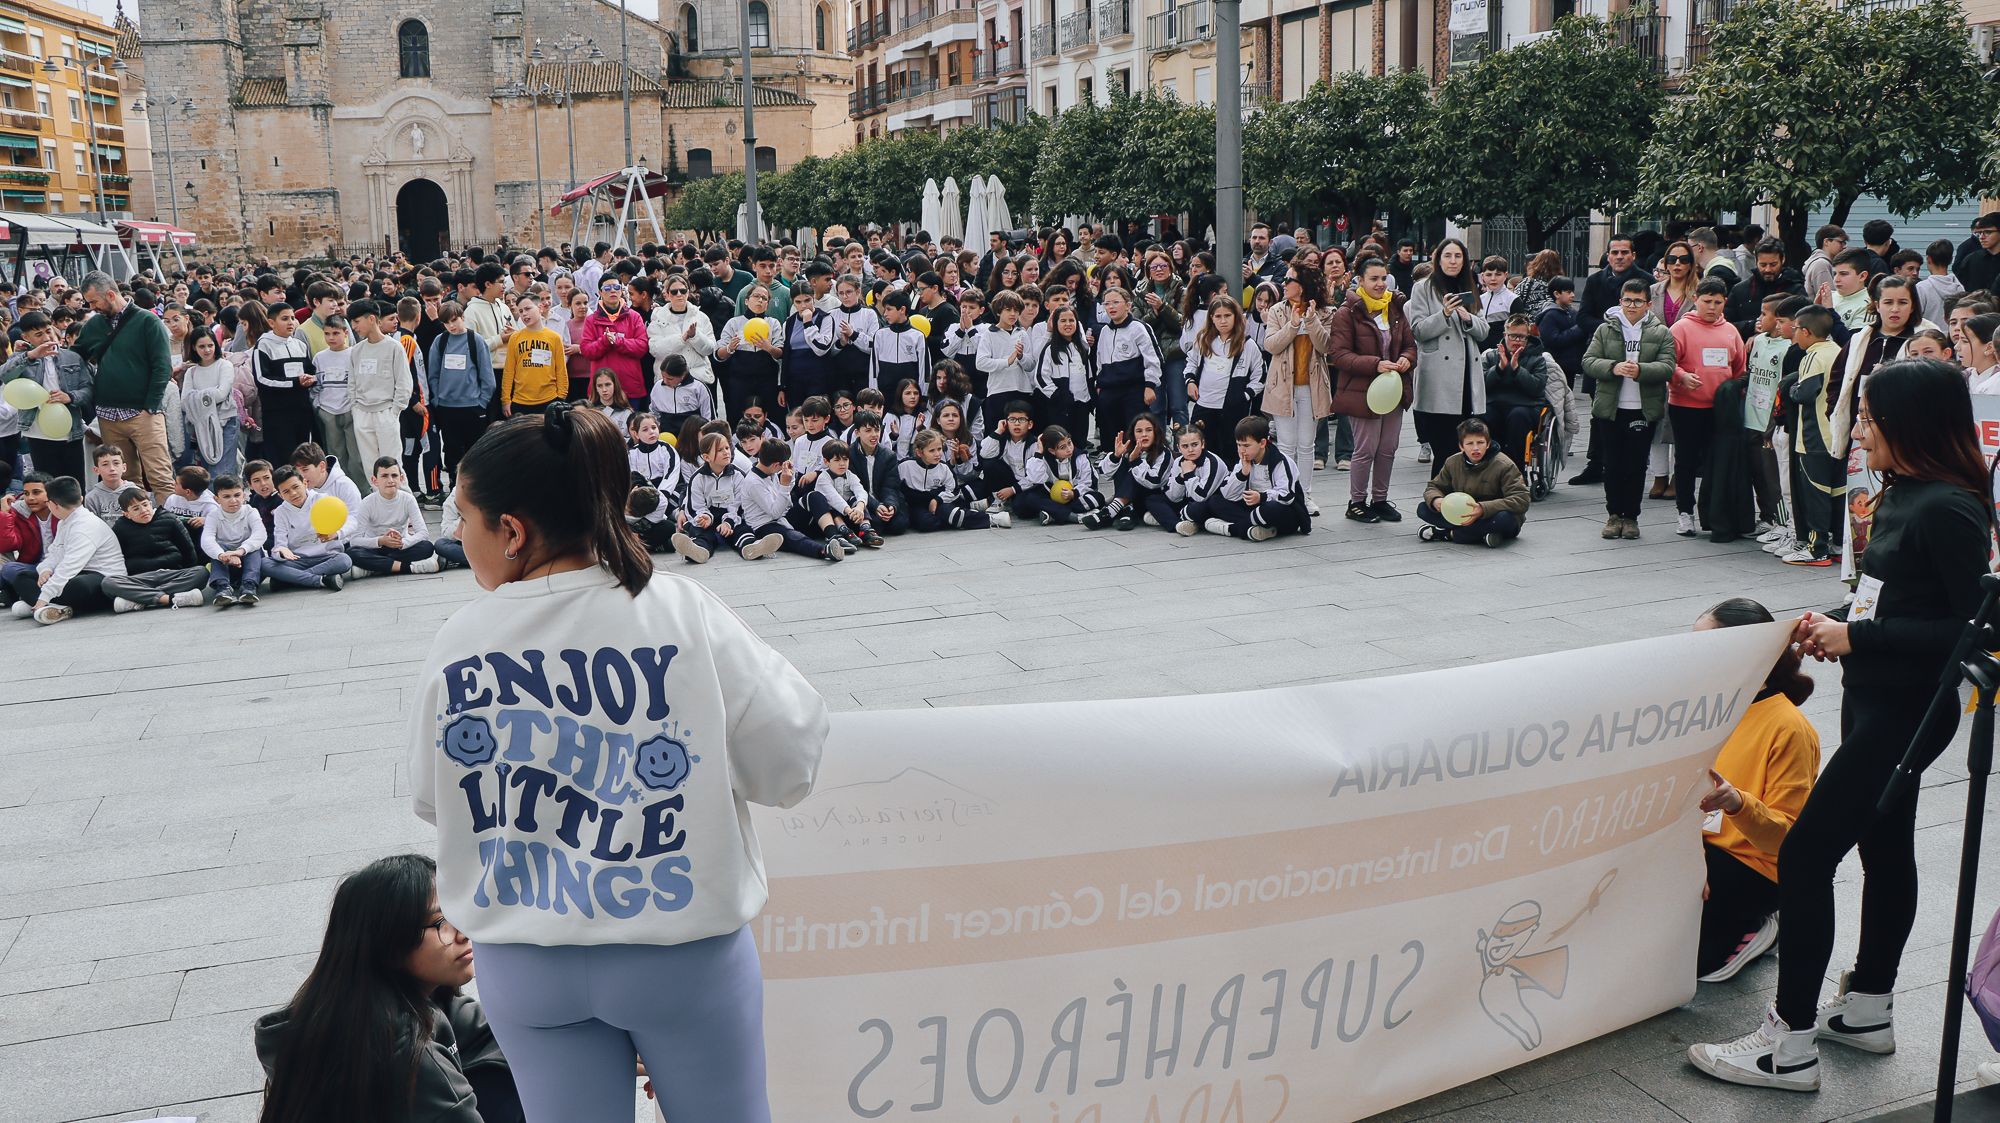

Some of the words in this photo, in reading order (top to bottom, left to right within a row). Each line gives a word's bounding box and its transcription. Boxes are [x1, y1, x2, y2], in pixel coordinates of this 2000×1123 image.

[518, 339, 550, 355] ATLANTA
[443, 645, 679, 725] ENJOY
[495, 709, 635, 806] THE
[459, 763, 687, 862] LITTLE
[474, 837, 694, 920] THINGS
